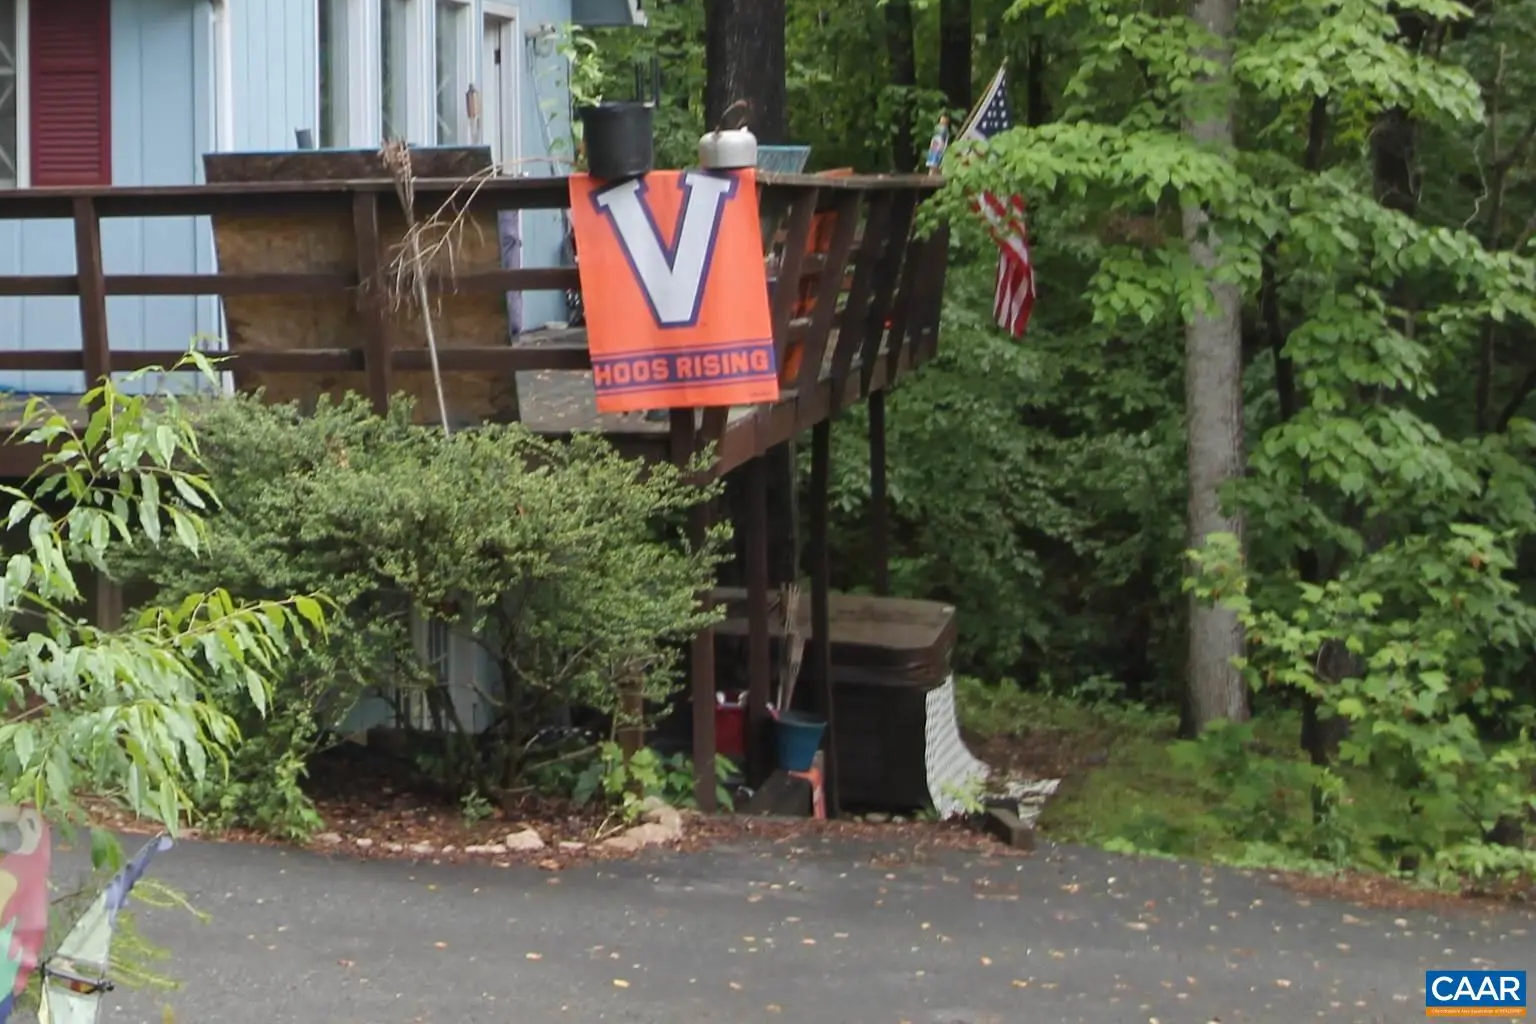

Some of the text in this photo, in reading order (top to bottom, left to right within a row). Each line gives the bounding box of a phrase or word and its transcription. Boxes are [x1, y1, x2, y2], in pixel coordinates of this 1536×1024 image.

[591, 171, 737, 327] V
[594, 348, 769, 387] HOOS RISING
